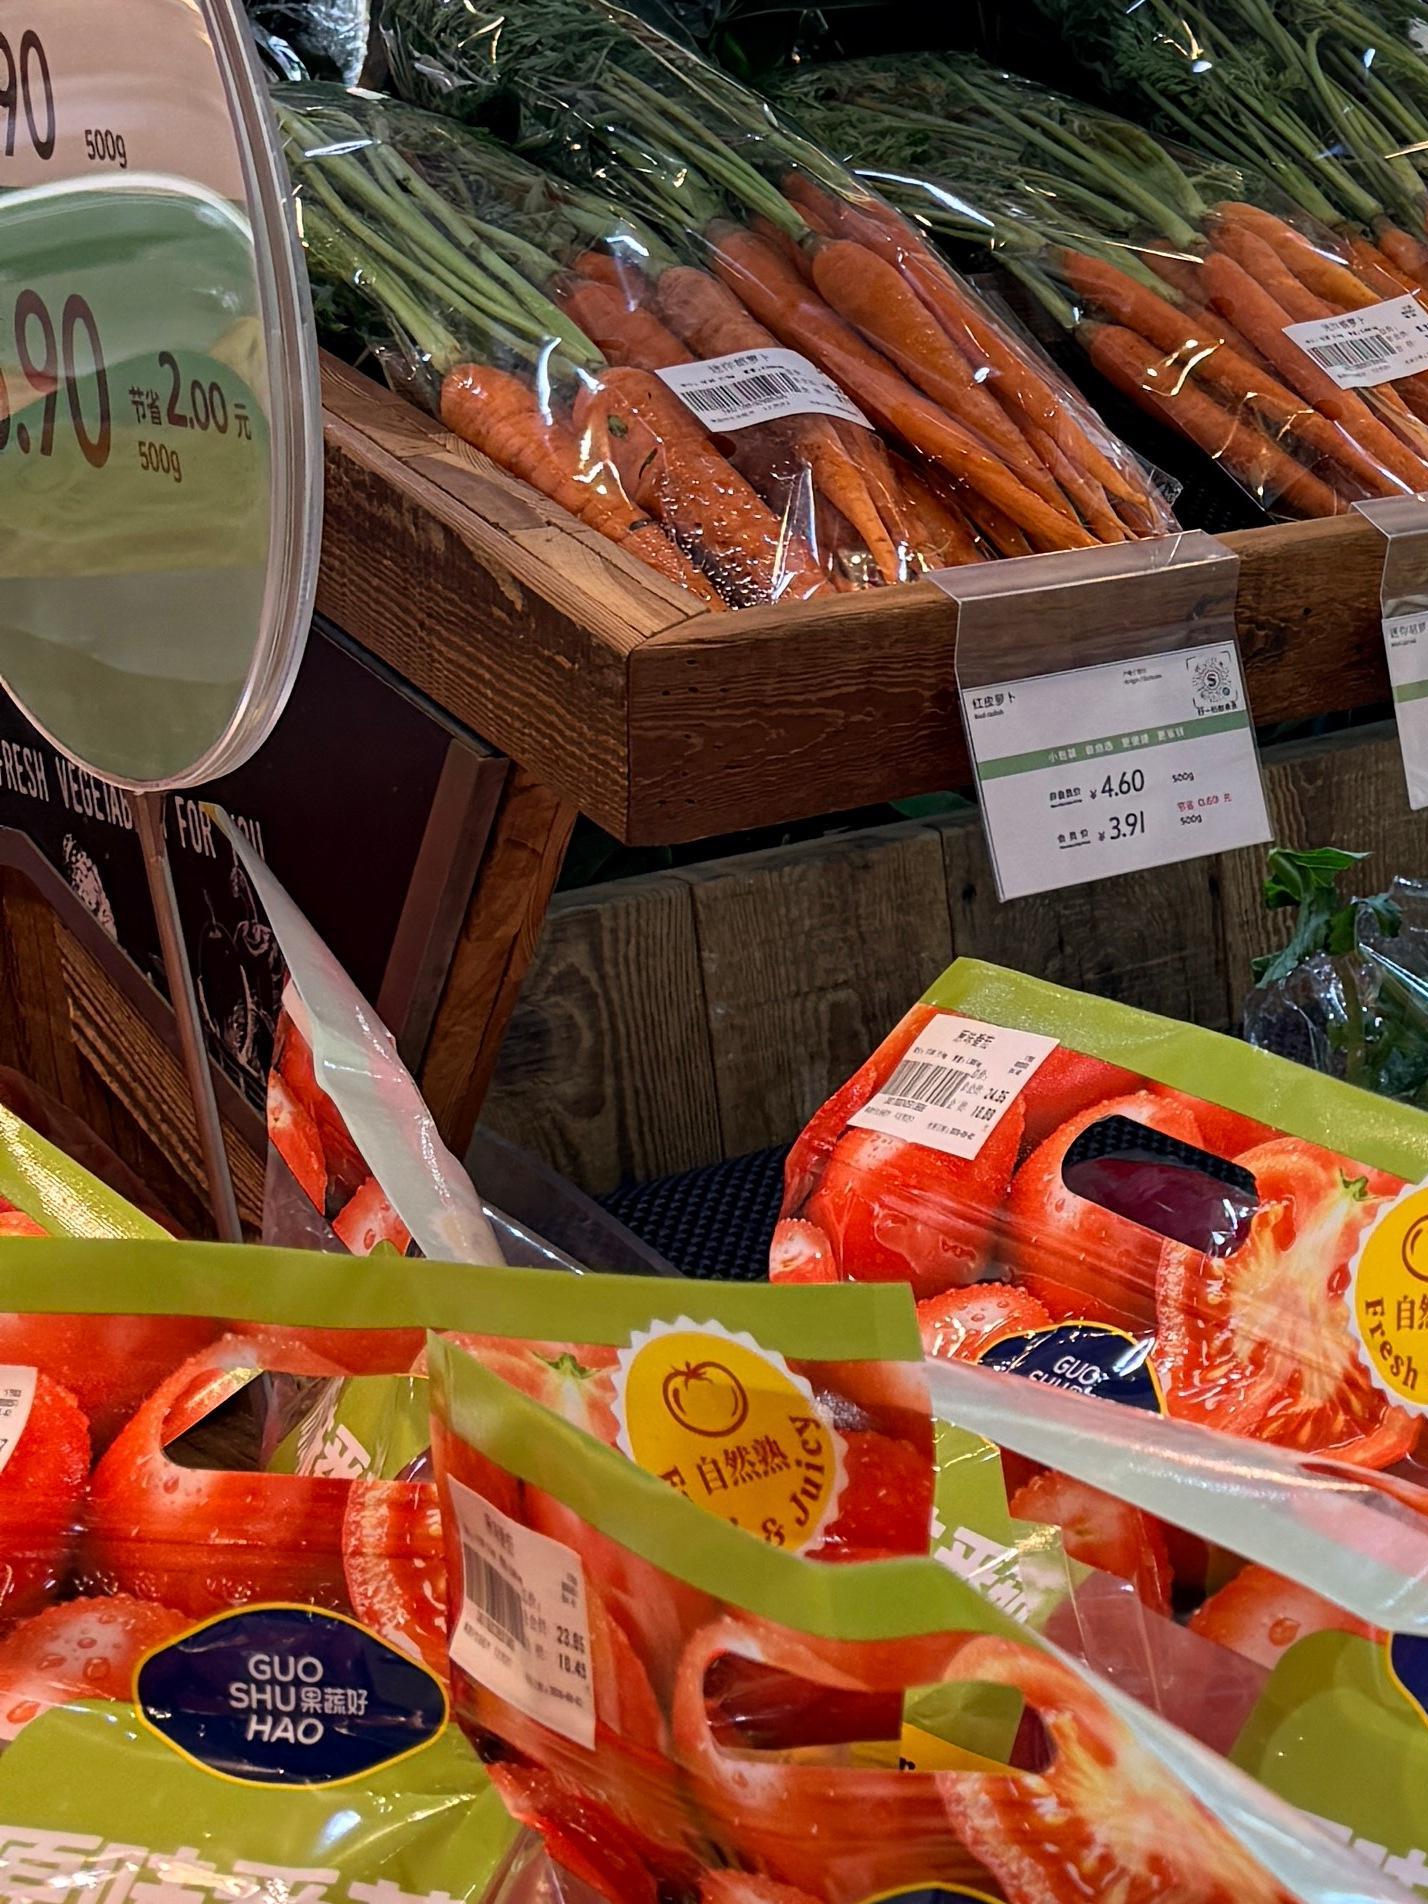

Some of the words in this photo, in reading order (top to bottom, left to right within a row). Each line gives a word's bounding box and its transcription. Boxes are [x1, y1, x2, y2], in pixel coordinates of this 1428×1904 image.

[85, 129, 127, 169] 500g
[0, 288, 111, 468] .90
[138, 441, 182, 483] 500g
[1364, 1296, 1420, 1391] Fresh
[1053, 1356, 1102, 1385] GUO
[697, 1433, 791, 1495] 自然熟
[760, 1517, 786, 1546] &
[789, 1413, 827, 1528] Juicy
[248, 1653, 324, 1684] GUO
[228, 1681, 296, 1712] SHU
[300, 1686, 369, 1716] 果蔬好
[246, 1714, 325, 1745] HAO
